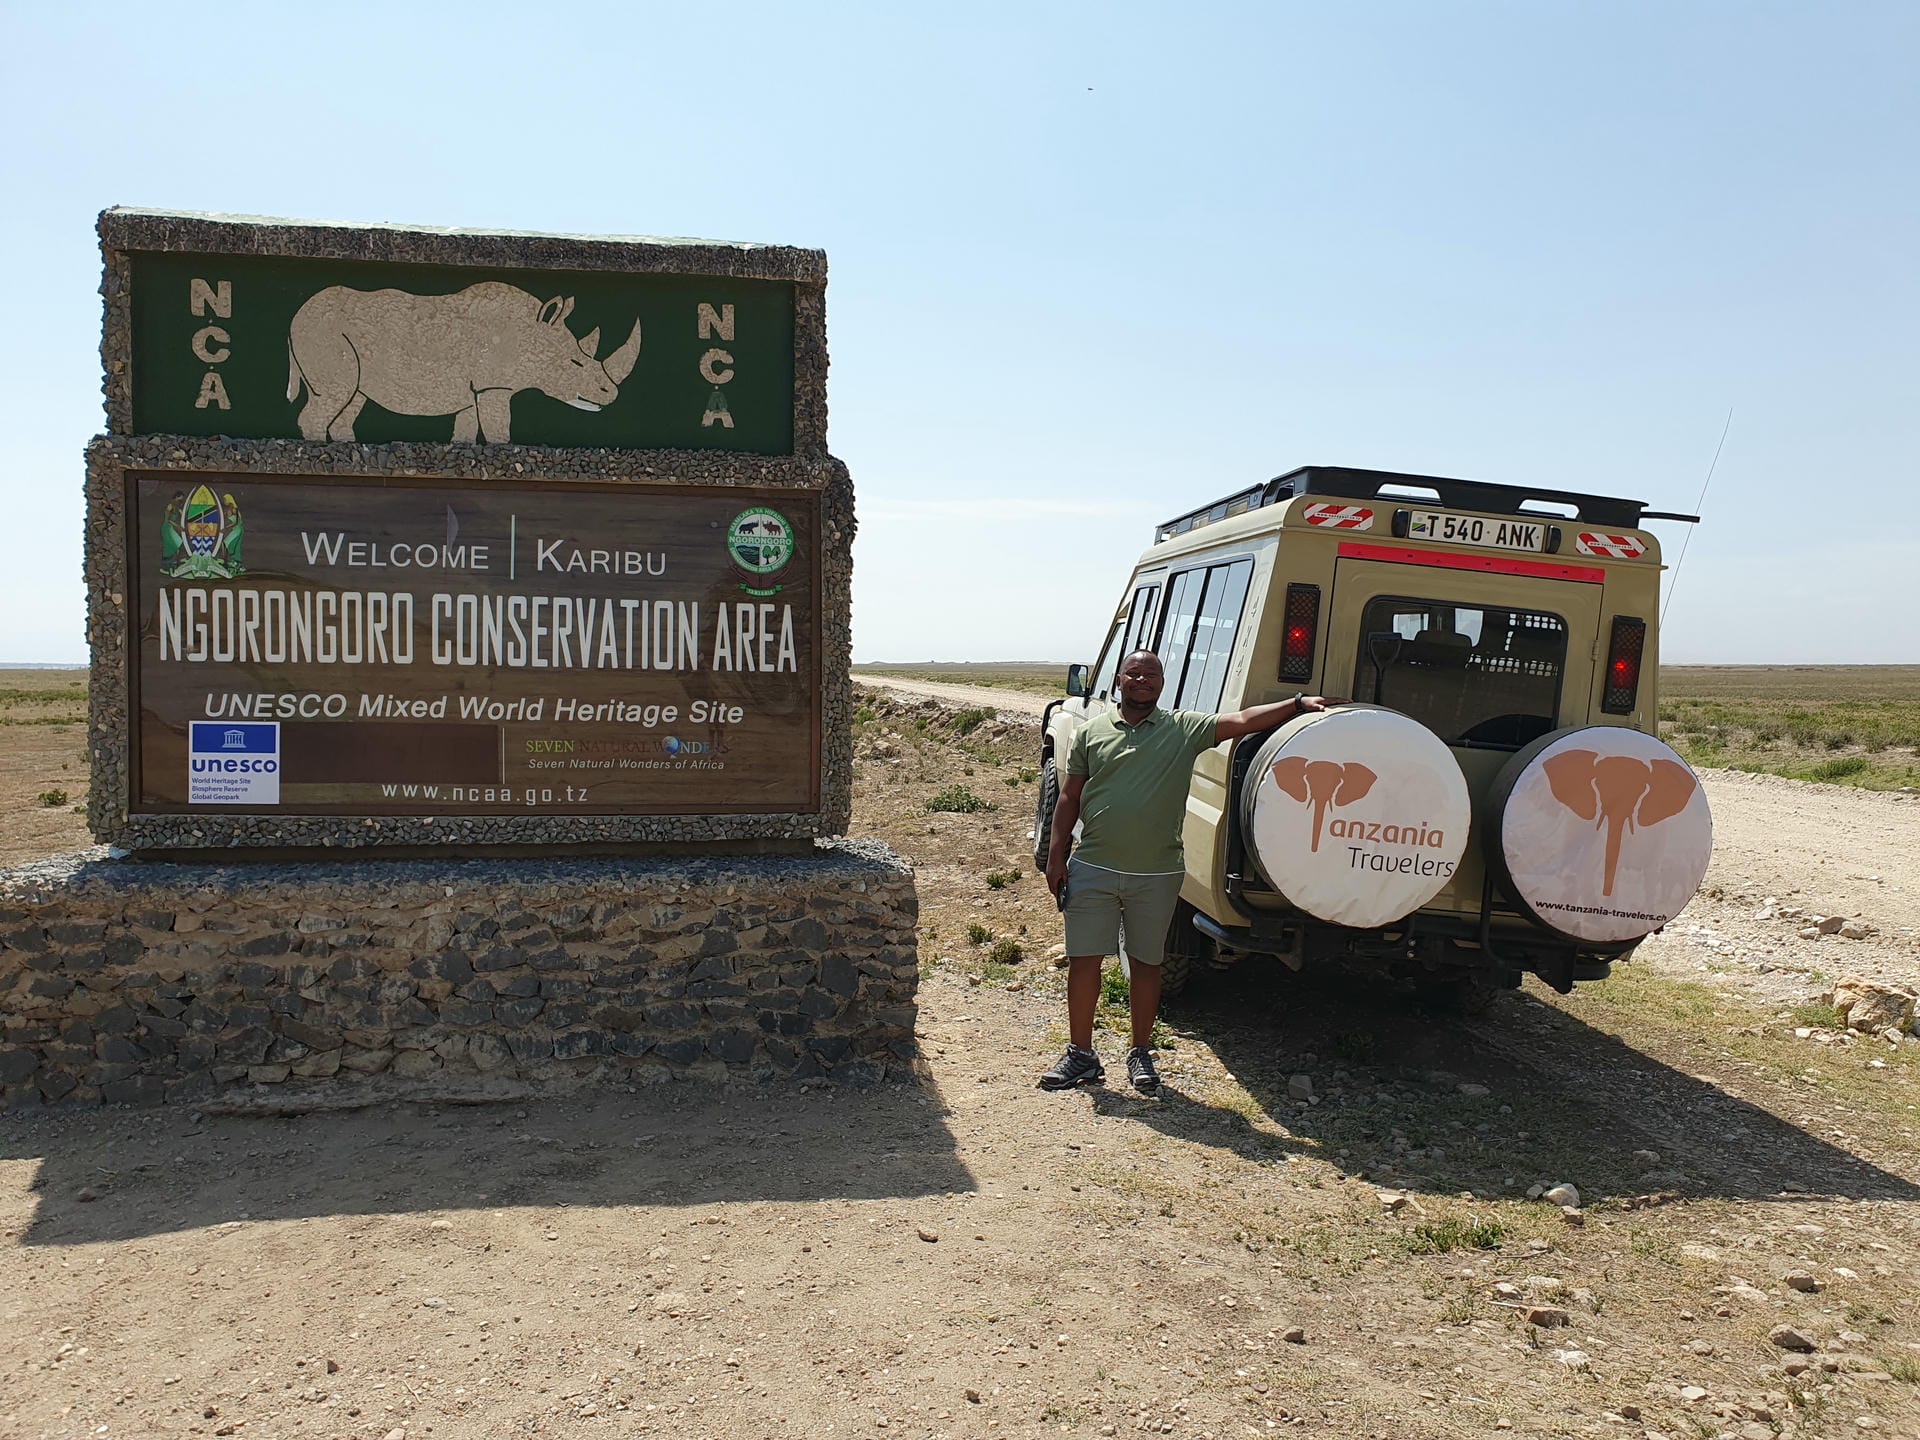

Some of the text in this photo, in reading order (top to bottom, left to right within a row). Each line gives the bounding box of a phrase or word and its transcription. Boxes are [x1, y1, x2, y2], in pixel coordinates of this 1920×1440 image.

[729, 536, 792, 546] NGORONGORO
[1495, 523, 1537, 548] ANK
[159, 587, 797, 673] NGORONGORO CONSERVATION AREA
[204, 693, 745, 728] UNESCO Mixed World Heritage Site
[526, 740, 575, 753] SEVEN
[192, 759, 277, 773] unesco
[528, 758, 725, 770] Seven Natural Wonders of Africa
[1347, 846, 1455, 878] Travelers
